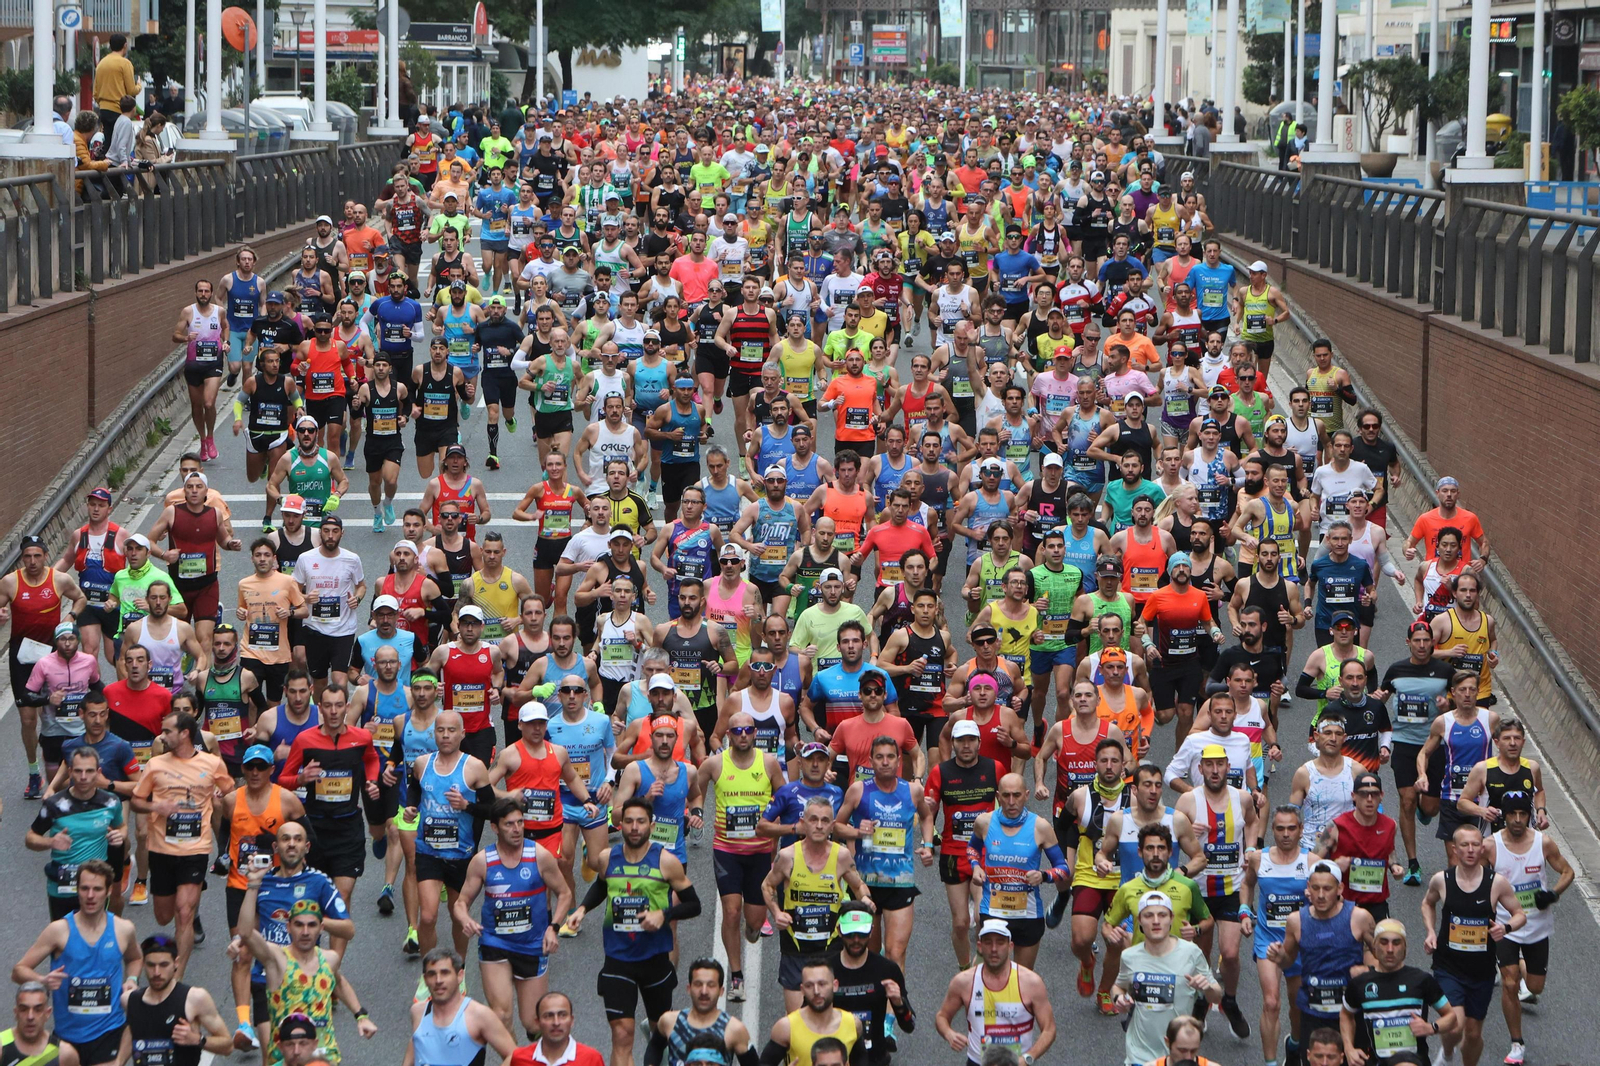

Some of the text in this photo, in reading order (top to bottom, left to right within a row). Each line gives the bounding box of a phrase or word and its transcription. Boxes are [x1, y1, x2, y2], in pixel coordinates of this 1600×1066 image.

[851, 45, 860, 56] P
[576, 48, 622, 67] MAS
[600, 444, 631, 453] OAKLEY
[297, 480, 324, 491] ETHIOPIA
[710, 613, 724, 621] RUN
[988, 854, 1028, 863] enerplus
[504, 899, 527, 907] ZURICH
[806, 906, 827, 914] ZURICH
[1386, 1018, 1410, 1026] ZURICH
